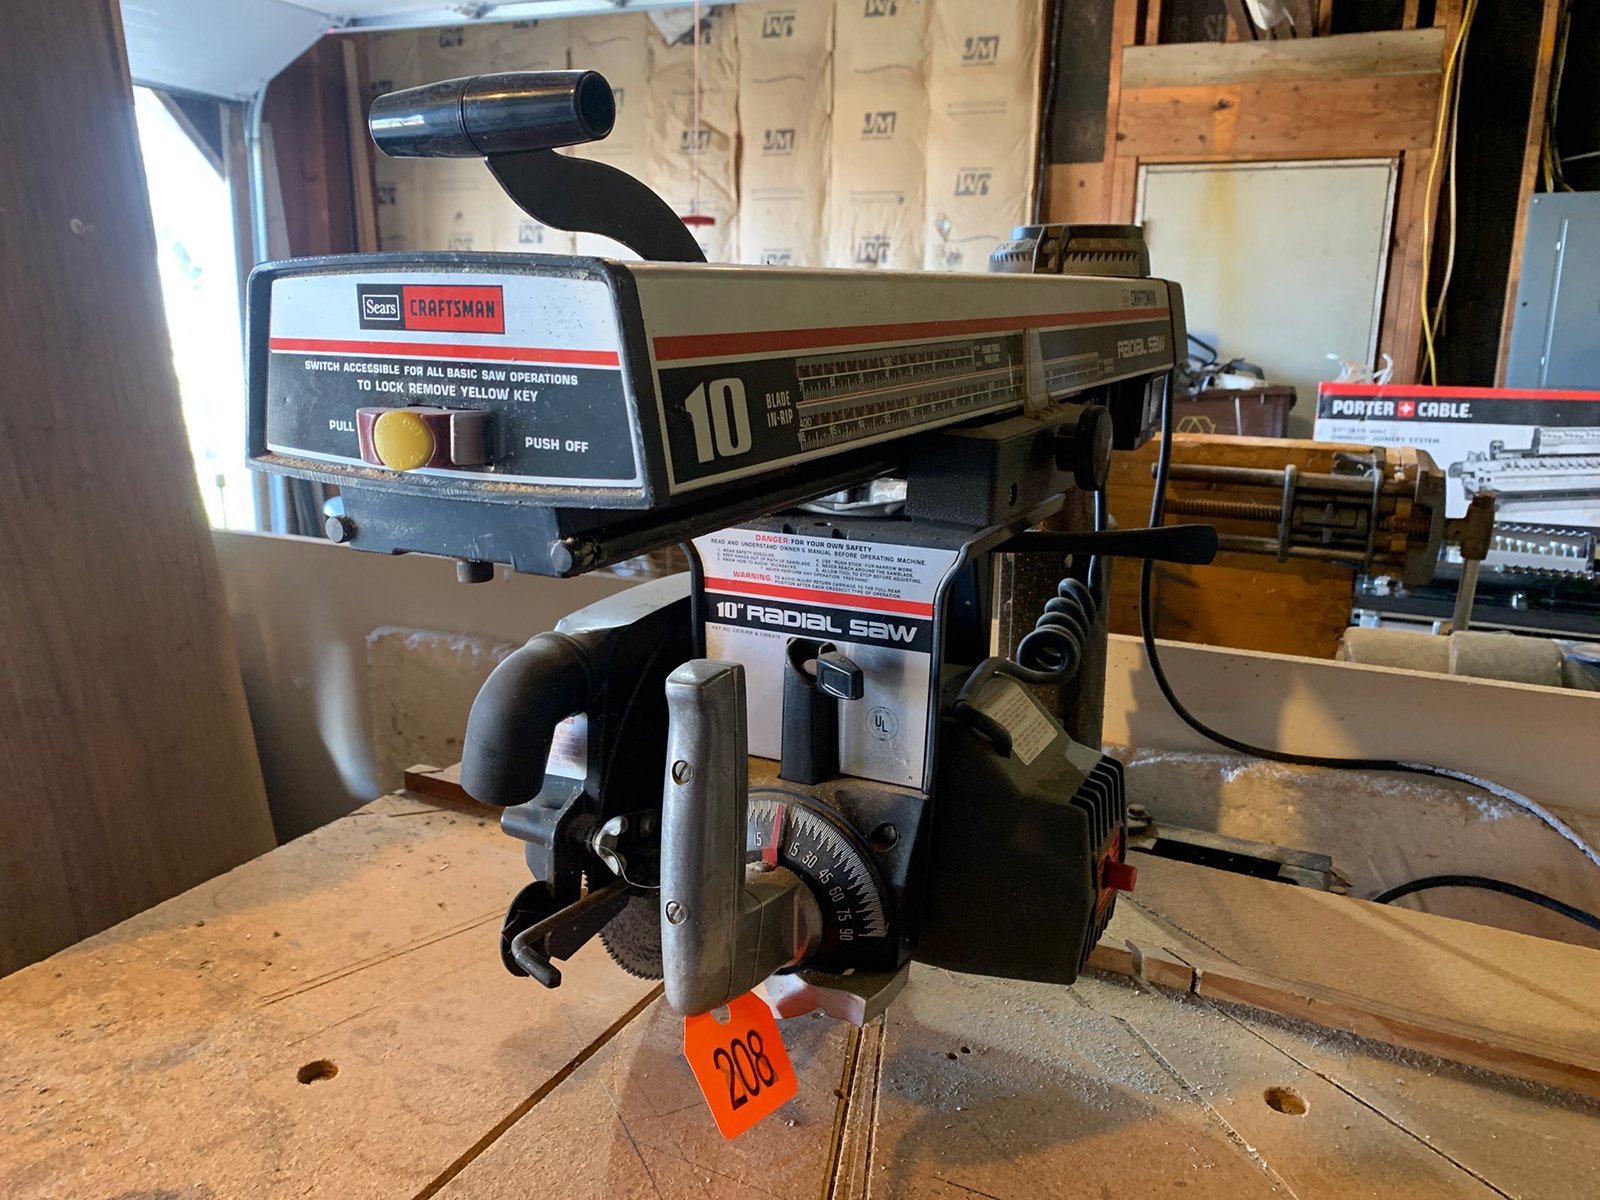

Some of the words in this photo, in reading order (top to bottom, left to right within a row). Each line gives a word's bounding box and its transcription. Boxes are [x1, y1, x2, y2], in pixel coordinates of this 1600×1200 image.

[366, 295, 397, 315] Sears
[410, 294, 496, 319] CRAFTSMAN
[304, 360, 340, 374] SWITCH
[343, 362, 399, 376] ACCESSIBLE
[404, 365, 423, 376] FOR
[426, 366, 444, 377] ALL
[447, 367, 477, 379] BASIC
[482, 370, 506, 381] SAW
[510, 371, 578, 386] OPERATIONS
[357, 379, 372, 390] TO
[375, 380, 404, 392] LOCK
[409, 382, 456, 397] REMOVE
[461, 385, 509, 401] YELLOW
[513, 388, 538, 402] KEY
[766, 390, 792, 410] BLADE
[1332, 400, 1394, 416] PORTER
[329, 419, 354, 432] PULL
[685, 377, 752, 464] 10
[767, 407, 794, 428] IN-RIP
[525, 437, 559, 450] PUSH
[565, 440, 589, 453] OFF
[741, 542, 777, 550] UNDERSTAND
[860, 554, 894, 562] OPERATING
[897, 557, 926, 565] MACHINE.
[806, 540, 824, 548] YOUR
[846, 544, 872, 552] SAFETY
[733, 571, 772, 581] WARNING:
[716, 602, 744, 619] 10"
[747, 605, 841, 634] RADIAL
[849, 619, 917, 643] SAW
[875, 715, 888, 732] UL
[754, 832, 762, 846] 15
[788, 841, 800, 857] 15
[802, 851, 818, 868] 30
[819, 868, 834, 884] 45
[829, 886, 845, 902] 60
[836, 908, 852, 921] 75
[840, 928, 854, 941] 90
[713, 1029, 775, 1111] 208
